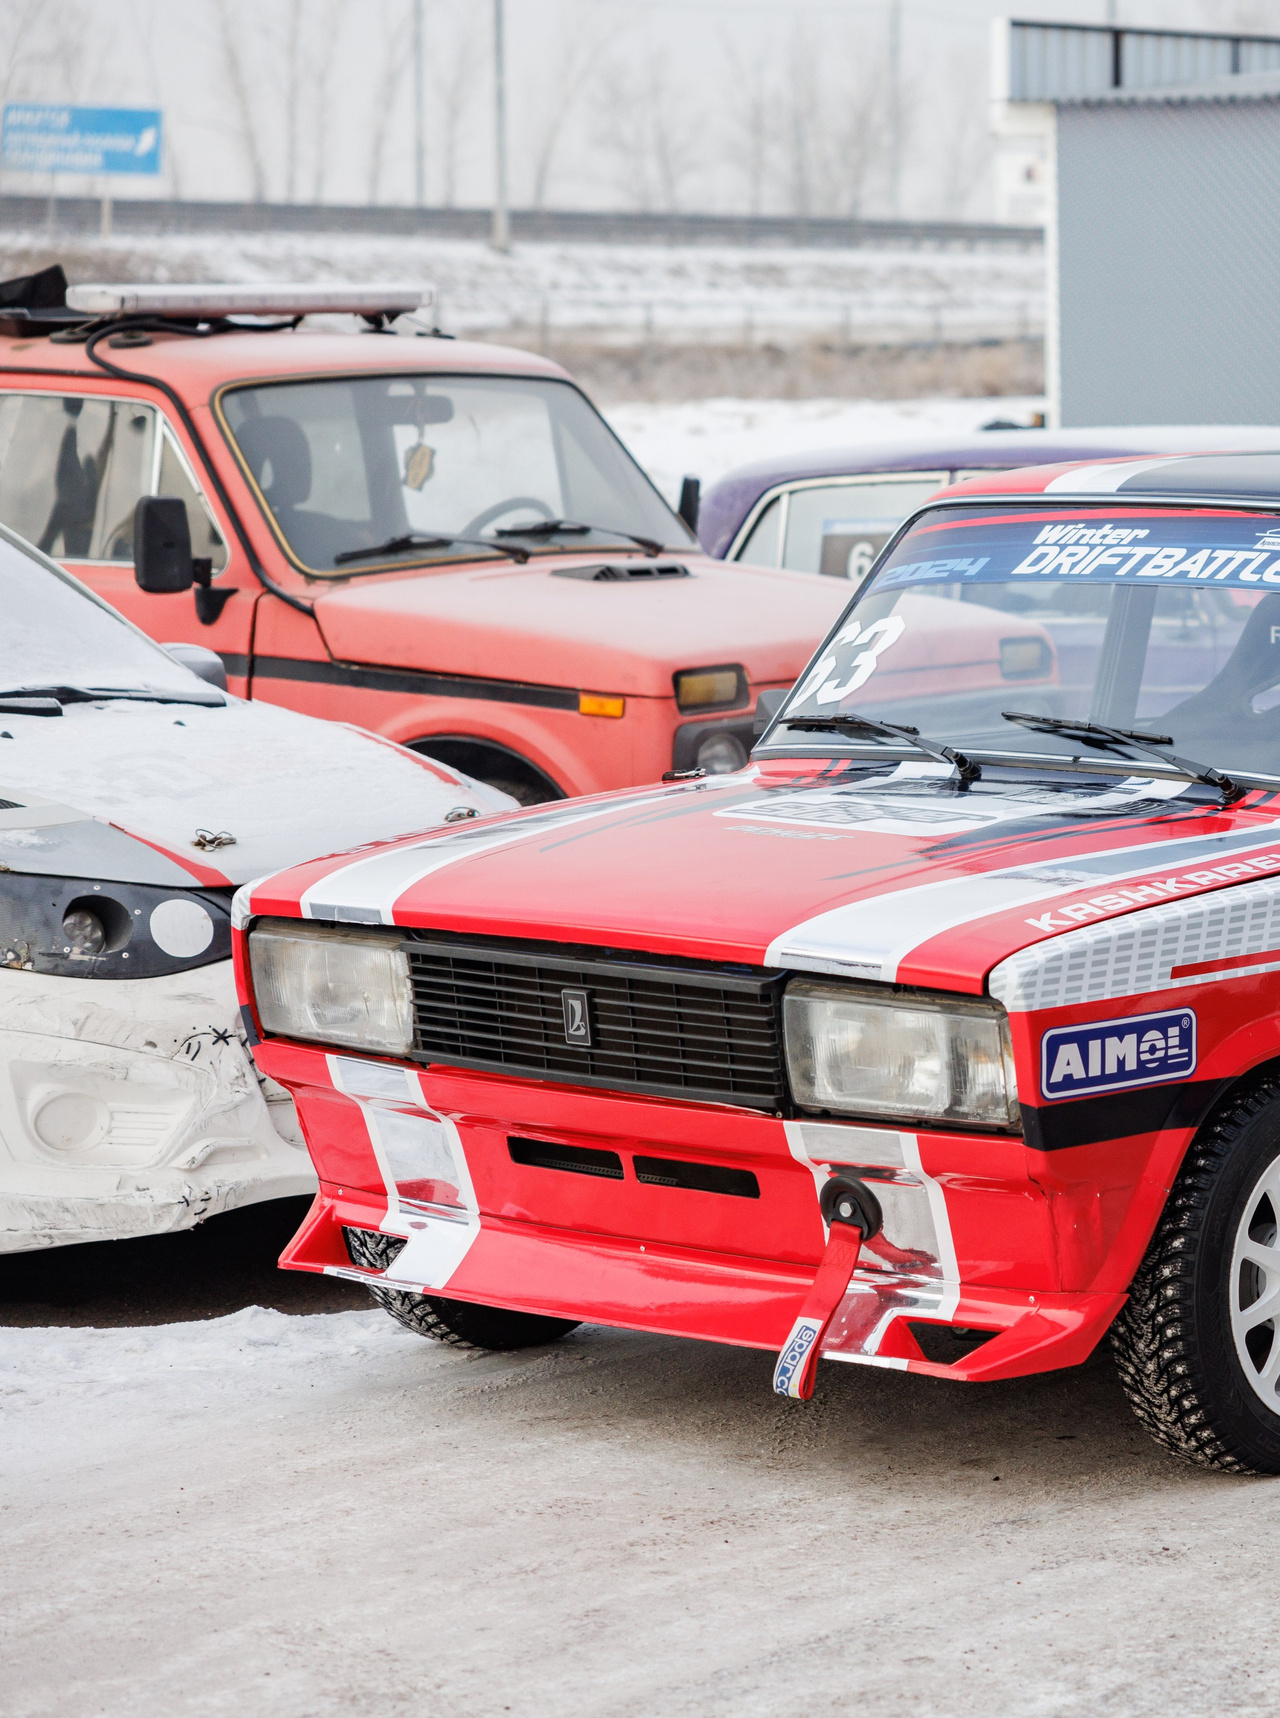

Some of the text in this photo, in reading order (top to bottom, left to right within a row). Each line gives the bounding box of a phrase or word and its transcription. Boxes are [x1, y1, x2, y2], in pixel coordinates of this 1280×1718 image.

[1031, 523, 1150, 545] Winter
[874, 557, 991, 589] 2024
[1049, 1024, 1189, 1084] AIMOL
